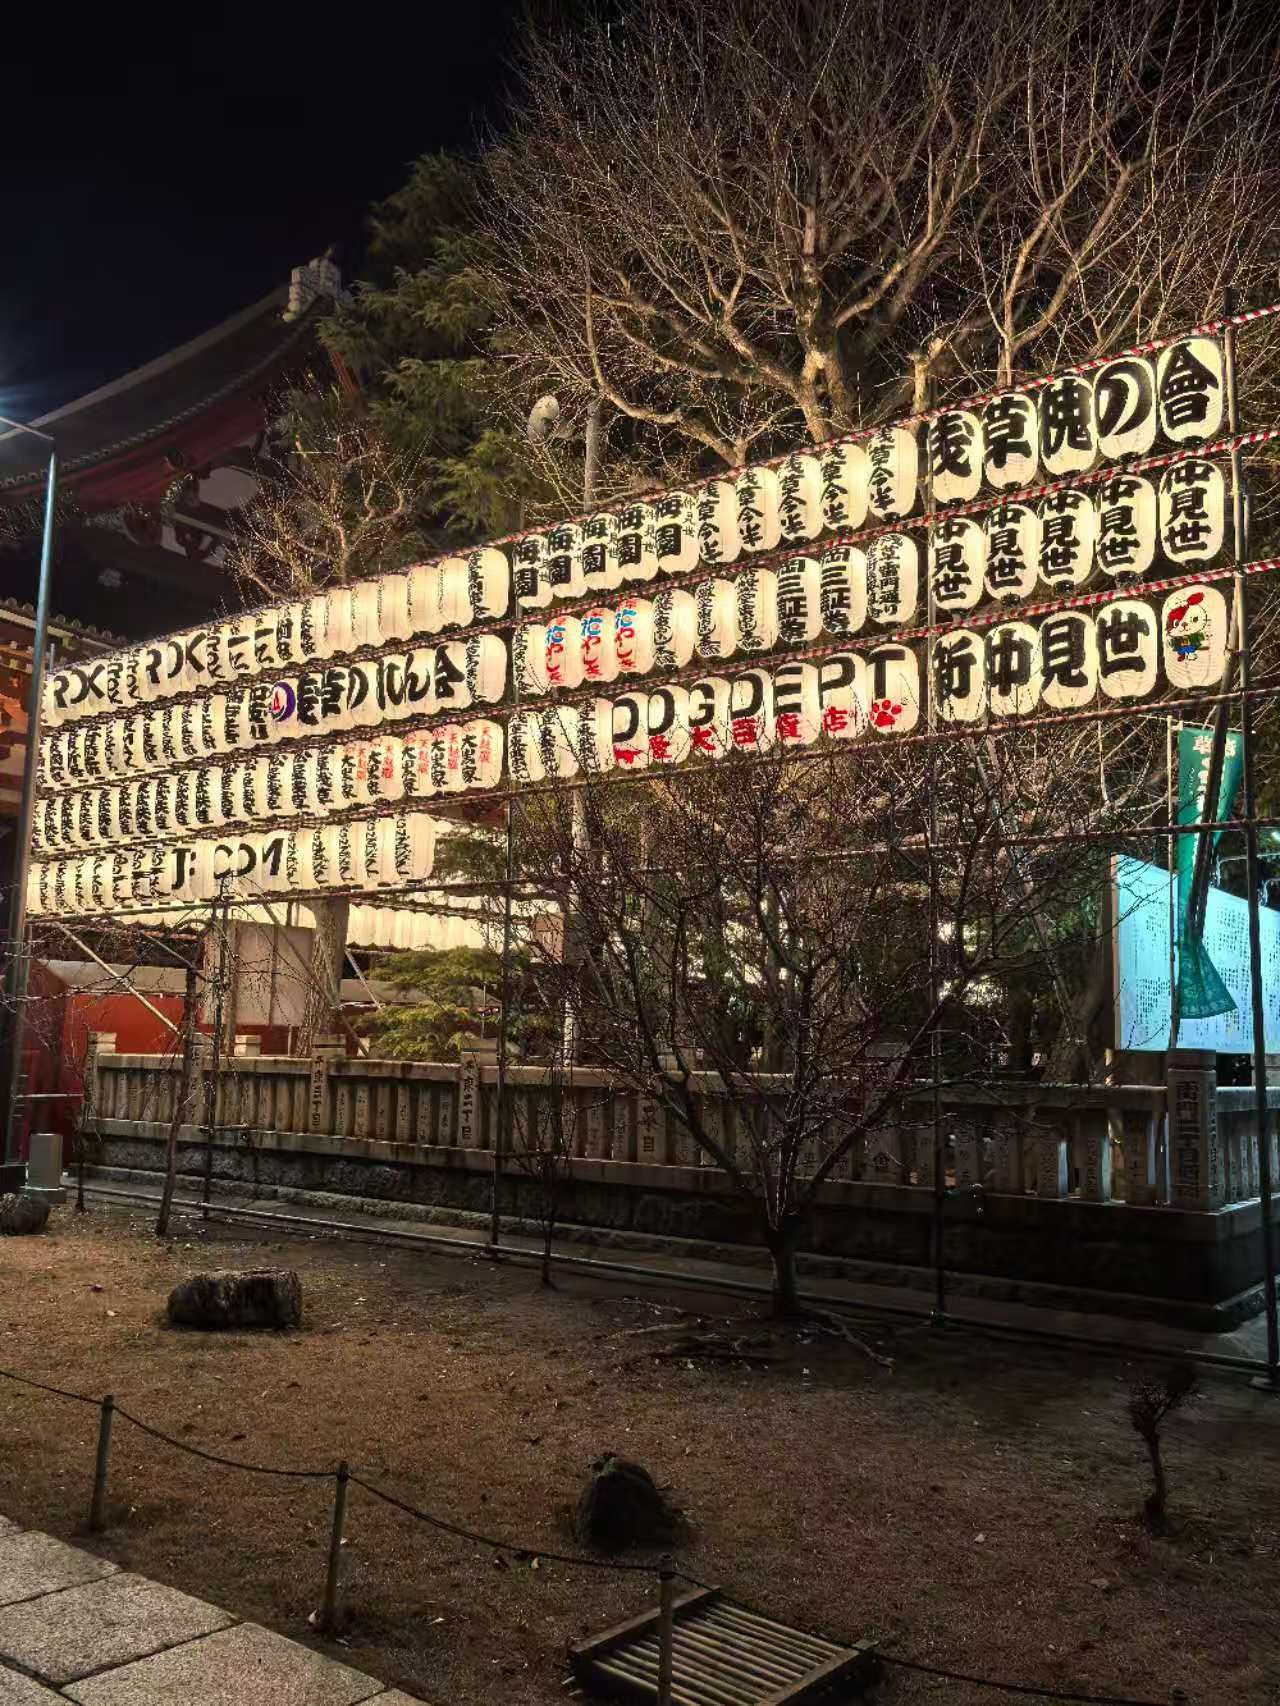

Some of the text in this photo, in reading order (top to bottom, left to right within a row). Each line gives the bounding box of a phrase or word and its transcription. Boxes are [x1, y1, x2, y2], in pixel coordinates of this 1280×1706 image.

[1037, 490, 1085, 579] 仲見世
[1095, 477, 1142, 569] 仲見世
[1161, 460, 1215, 555] 仲見世
